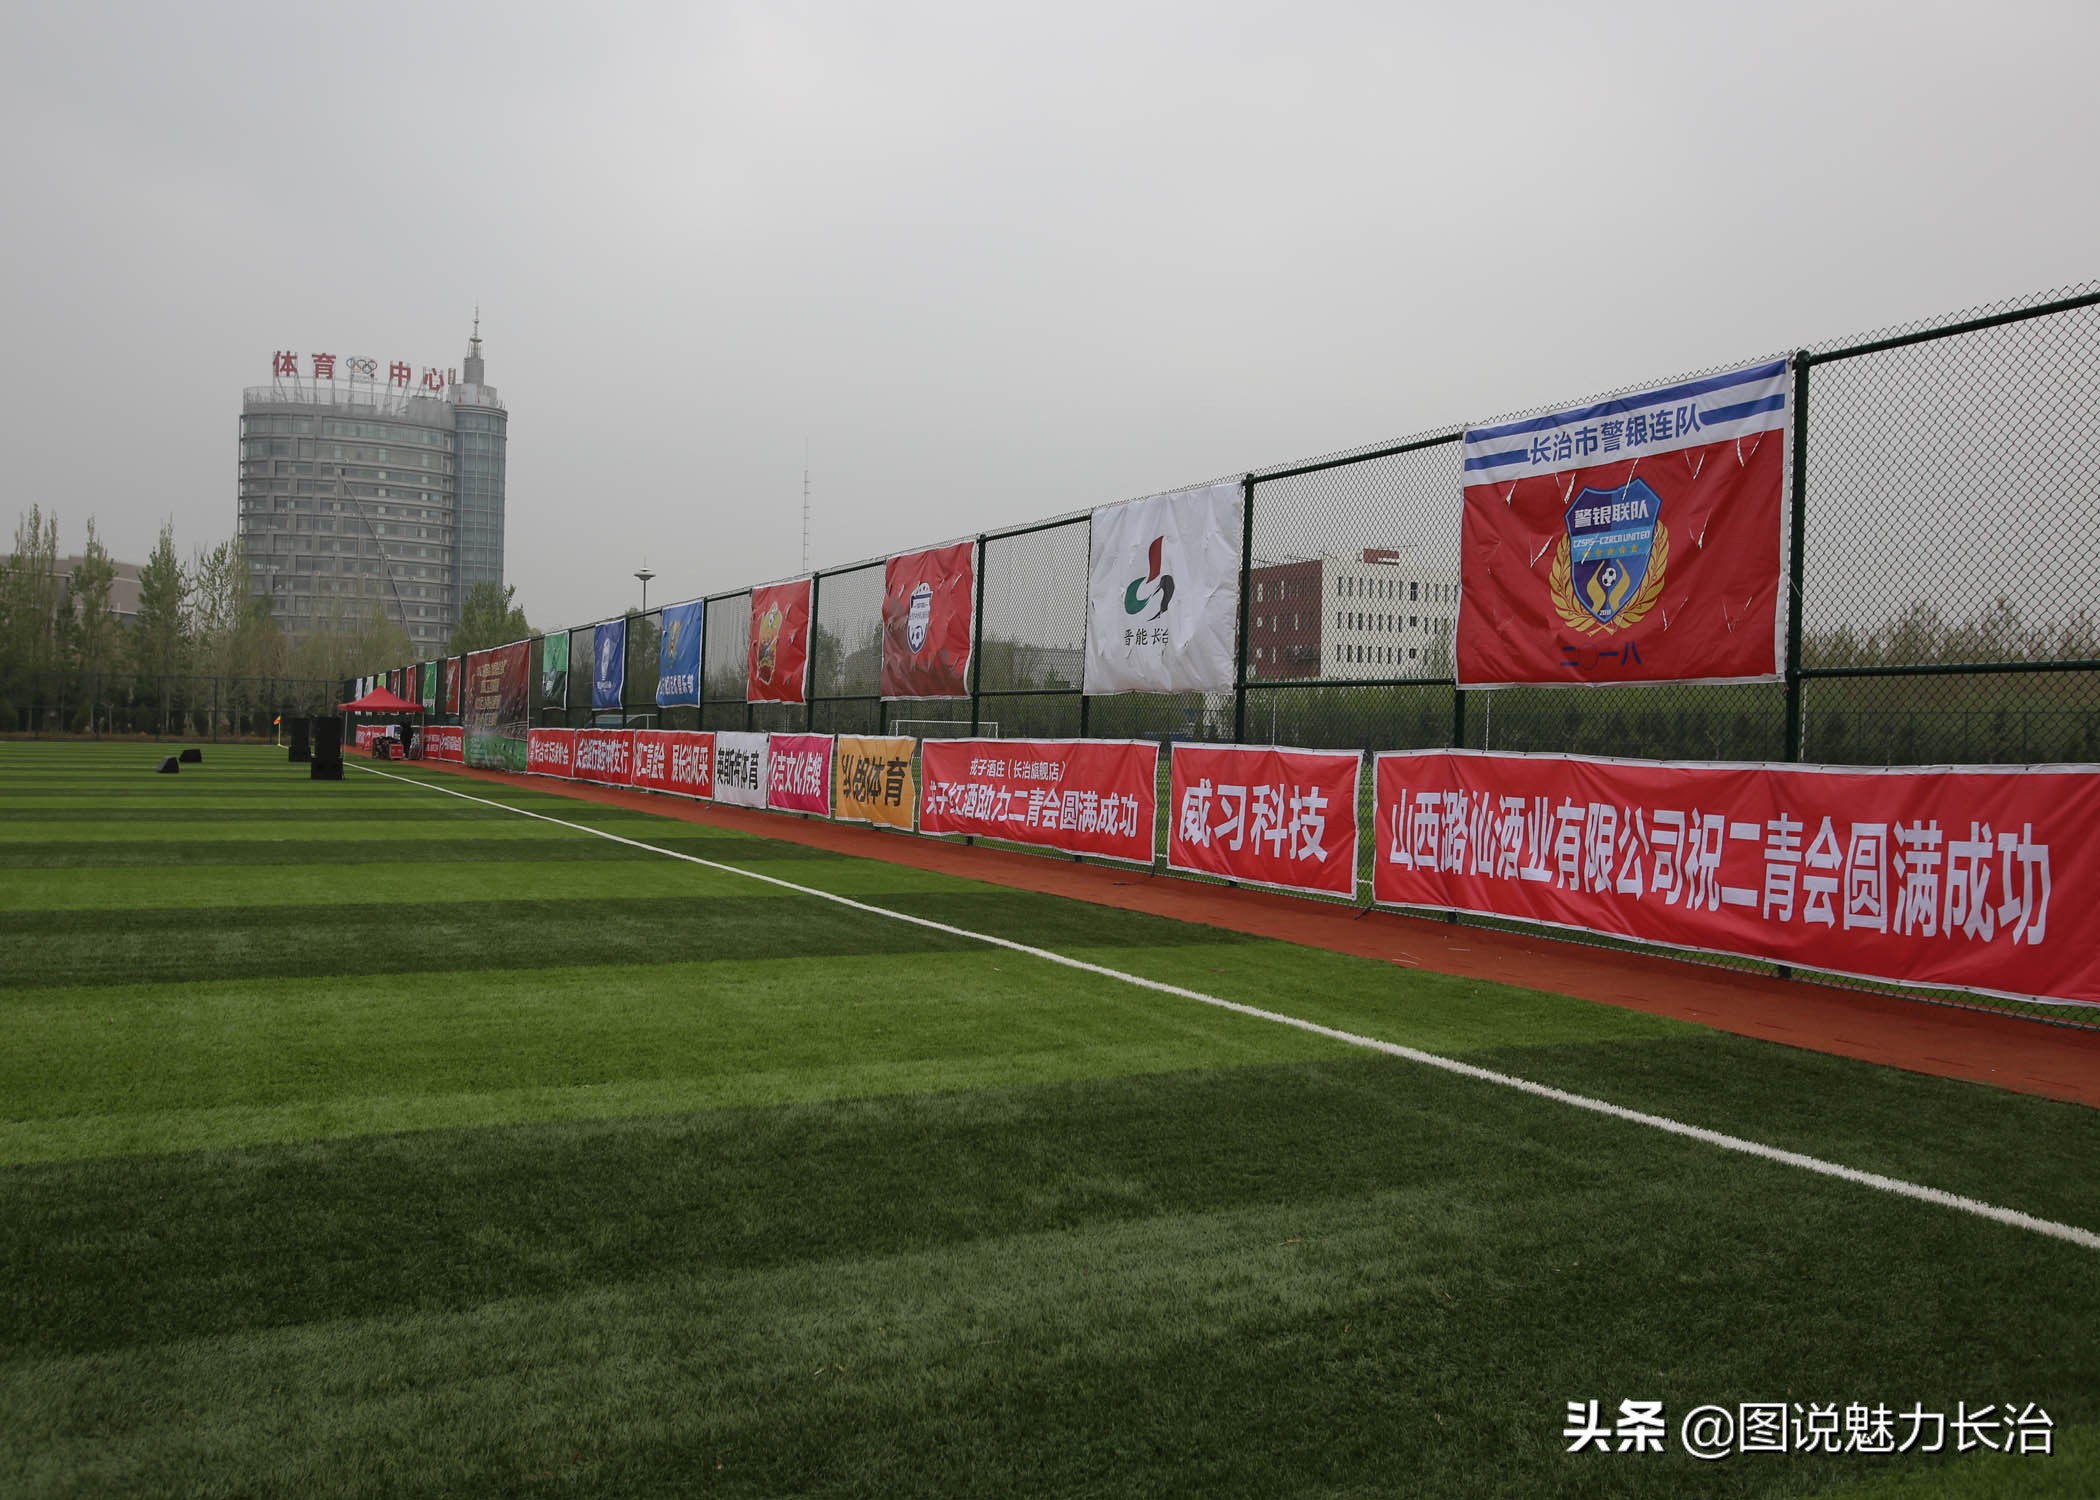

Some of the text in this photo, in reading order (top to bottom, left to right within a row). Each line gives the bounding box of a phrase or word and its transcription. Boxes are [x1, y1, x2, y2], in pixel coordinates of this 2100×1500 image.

[272, 350, 444, 391] 体育 中心
[1529, 403, 1702, 466] 长治市警银连队
[1574, 499, 1649, 529] 警银联队
[1178, 778, 1329, 863] 威习科技
